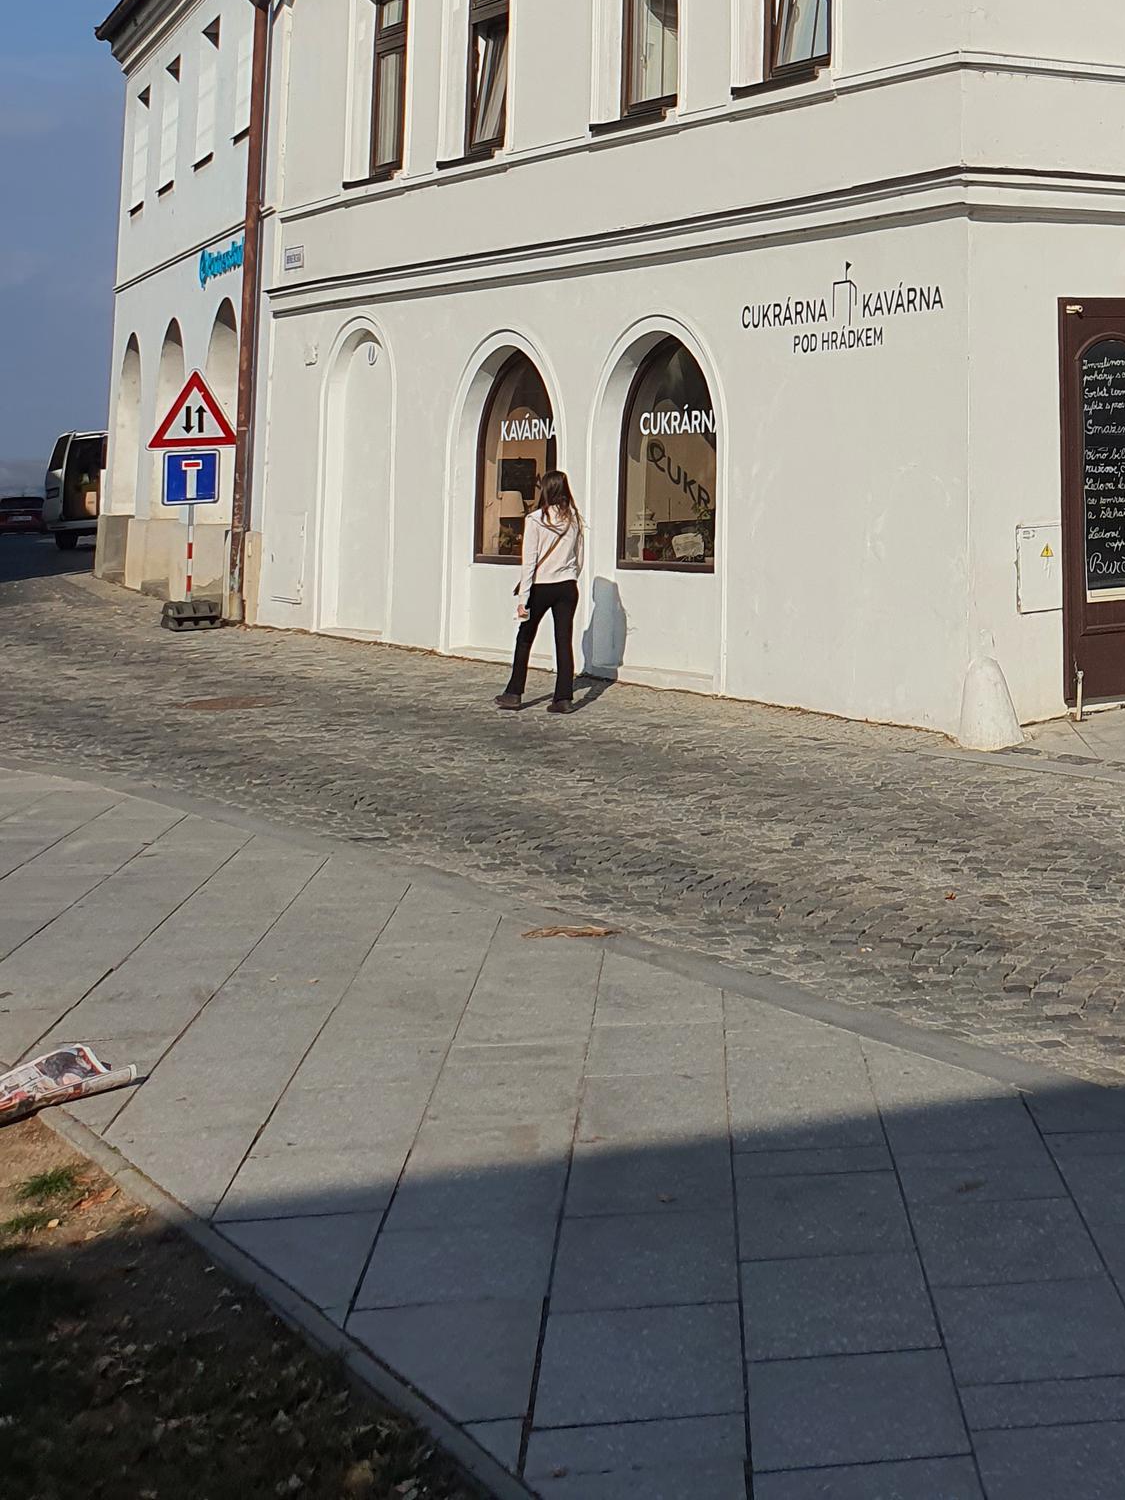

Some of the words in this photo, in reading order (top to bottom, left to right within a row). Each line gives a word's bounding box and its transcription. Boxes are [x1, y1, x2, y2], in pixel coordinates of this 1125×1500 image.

[741, 297, 828, 329] CUKRÁRNA
[862, 282, 944, 318] KAVÁRNA
[793, 333, 818, 354] POD
[821, 325, 884, 350] HRÁDKEM
[1084, 386, 1109, 399] Sorbet
[1088, 511, 1097, 519] a
